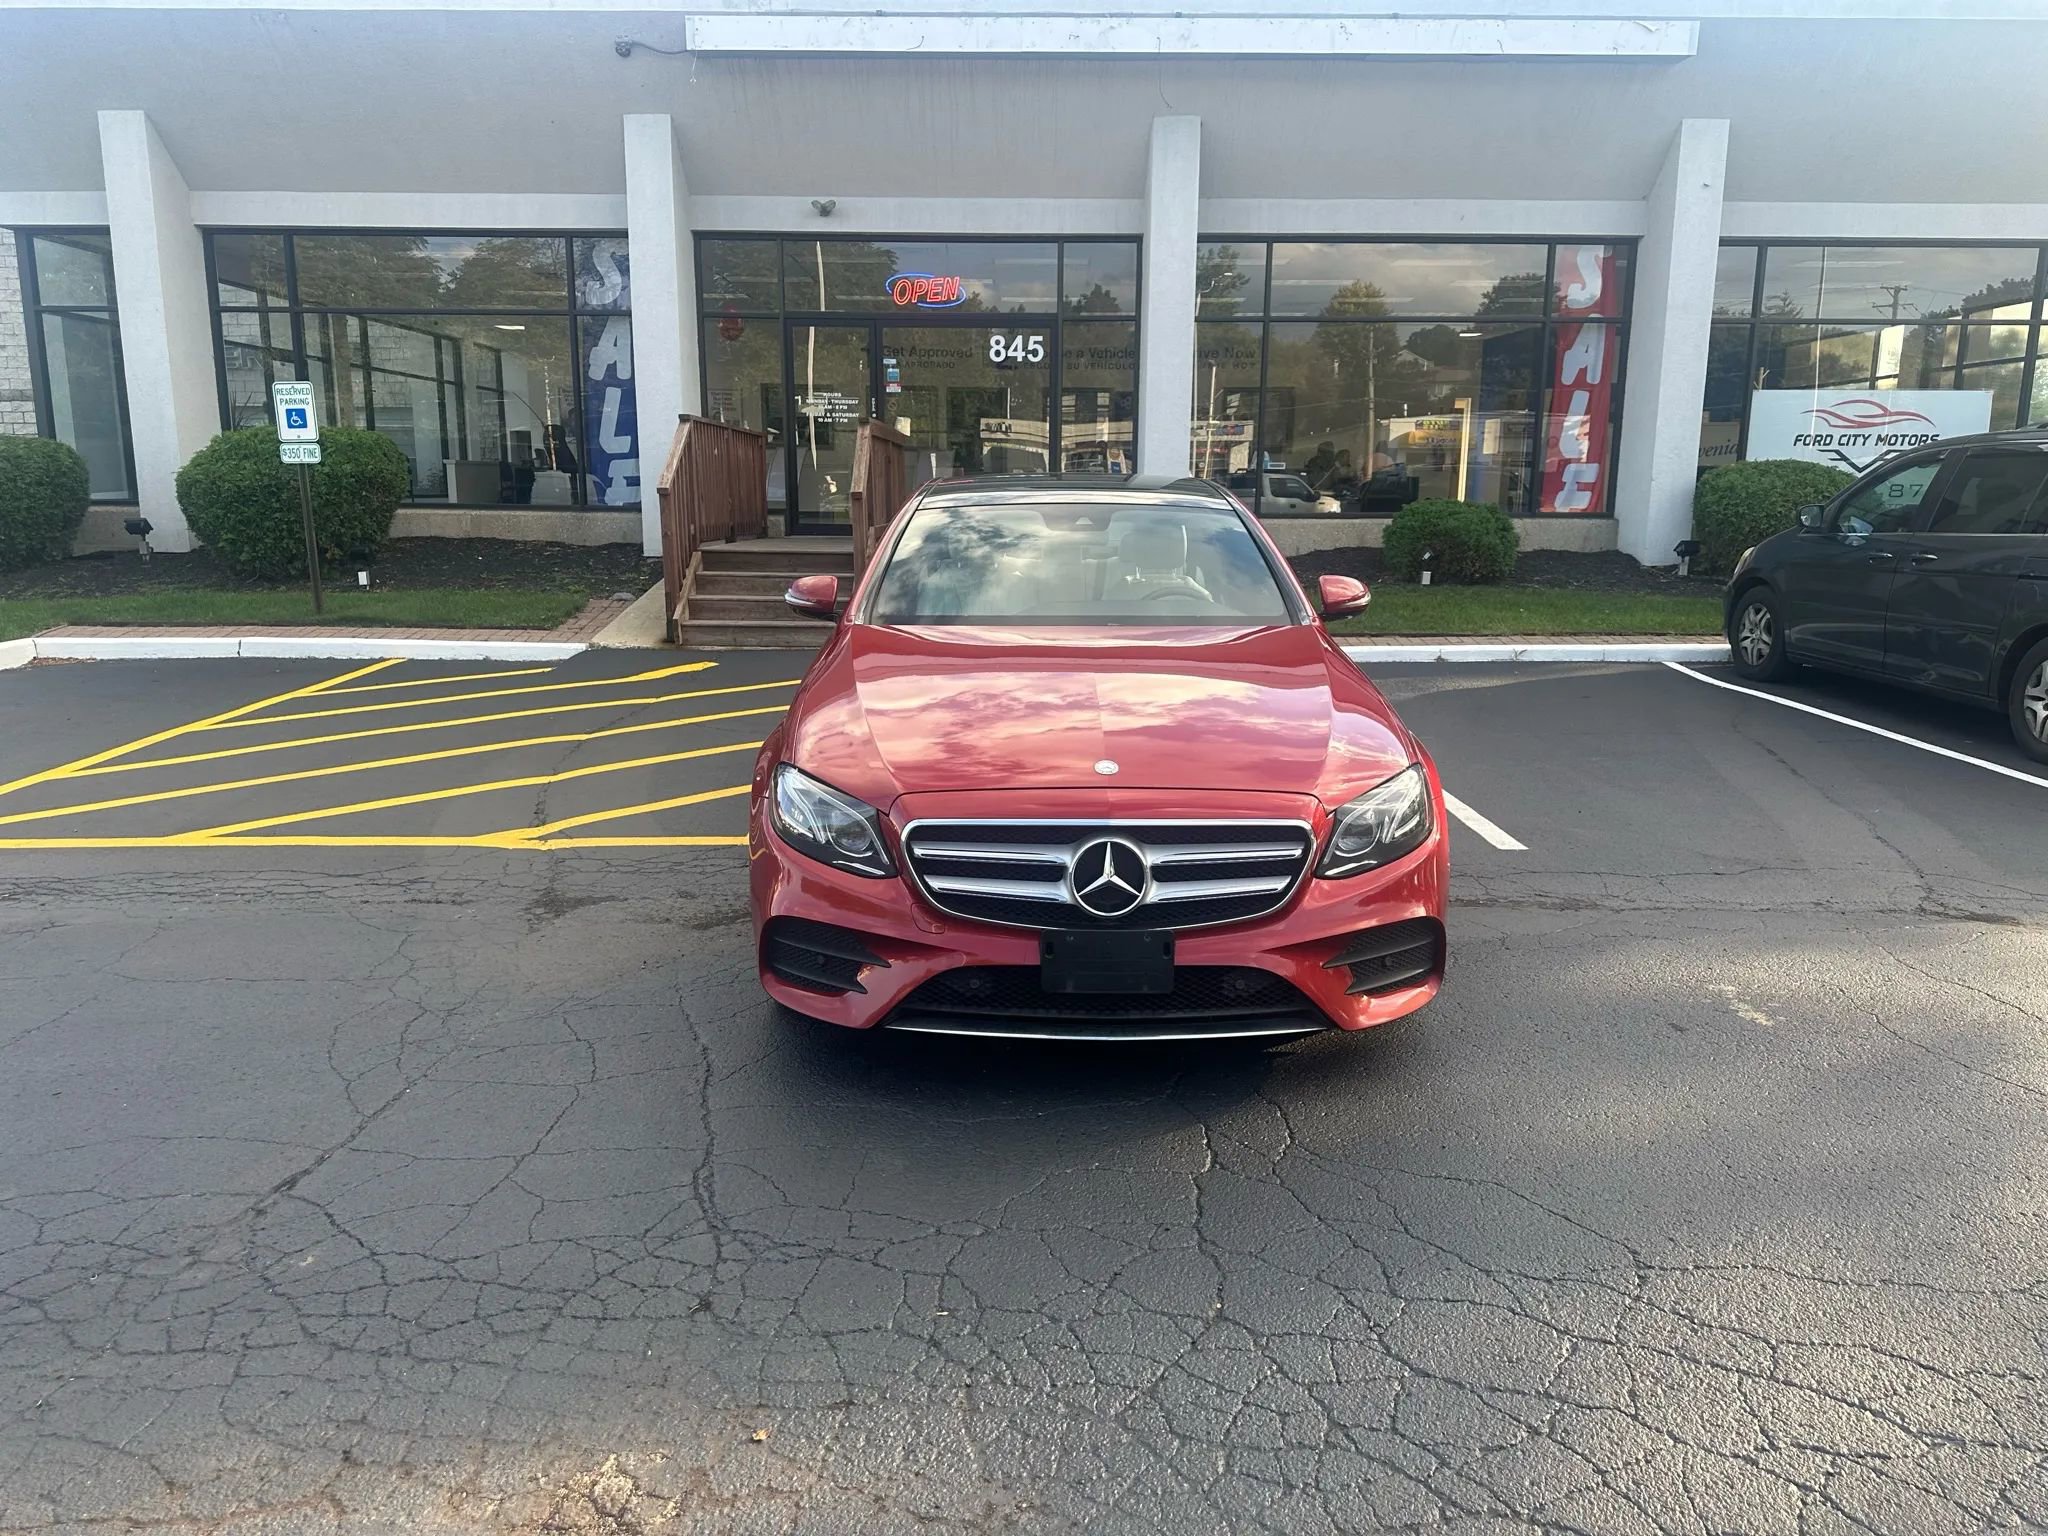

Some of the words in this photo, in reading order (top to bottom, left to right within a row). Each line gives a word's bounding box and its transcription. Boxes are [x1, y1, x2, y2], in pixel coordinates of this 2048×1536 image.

[893, 276, 960, 305] OPEN
[908, 346, 973, 359] Approved
[989, 335, 1044, 362] 845
[1088, 347, 1136, 359] Vehicle
[1225, 347, 1257, 359] Now
[585, 240, 641, 506] SALE
[1554, 244, 1607, 512] SALE
[276, 387, 310, 396] RESERVED
[280, 397, 310, 406] PARKING
[1793, 434, 1833, 447] FORD
[1837, 434, 1872, 447] CITY
[1875, 434, 1940, 447] MOTORS
[282, 447, 301, 459] $350
[302, 447, 318, 459] FINE
